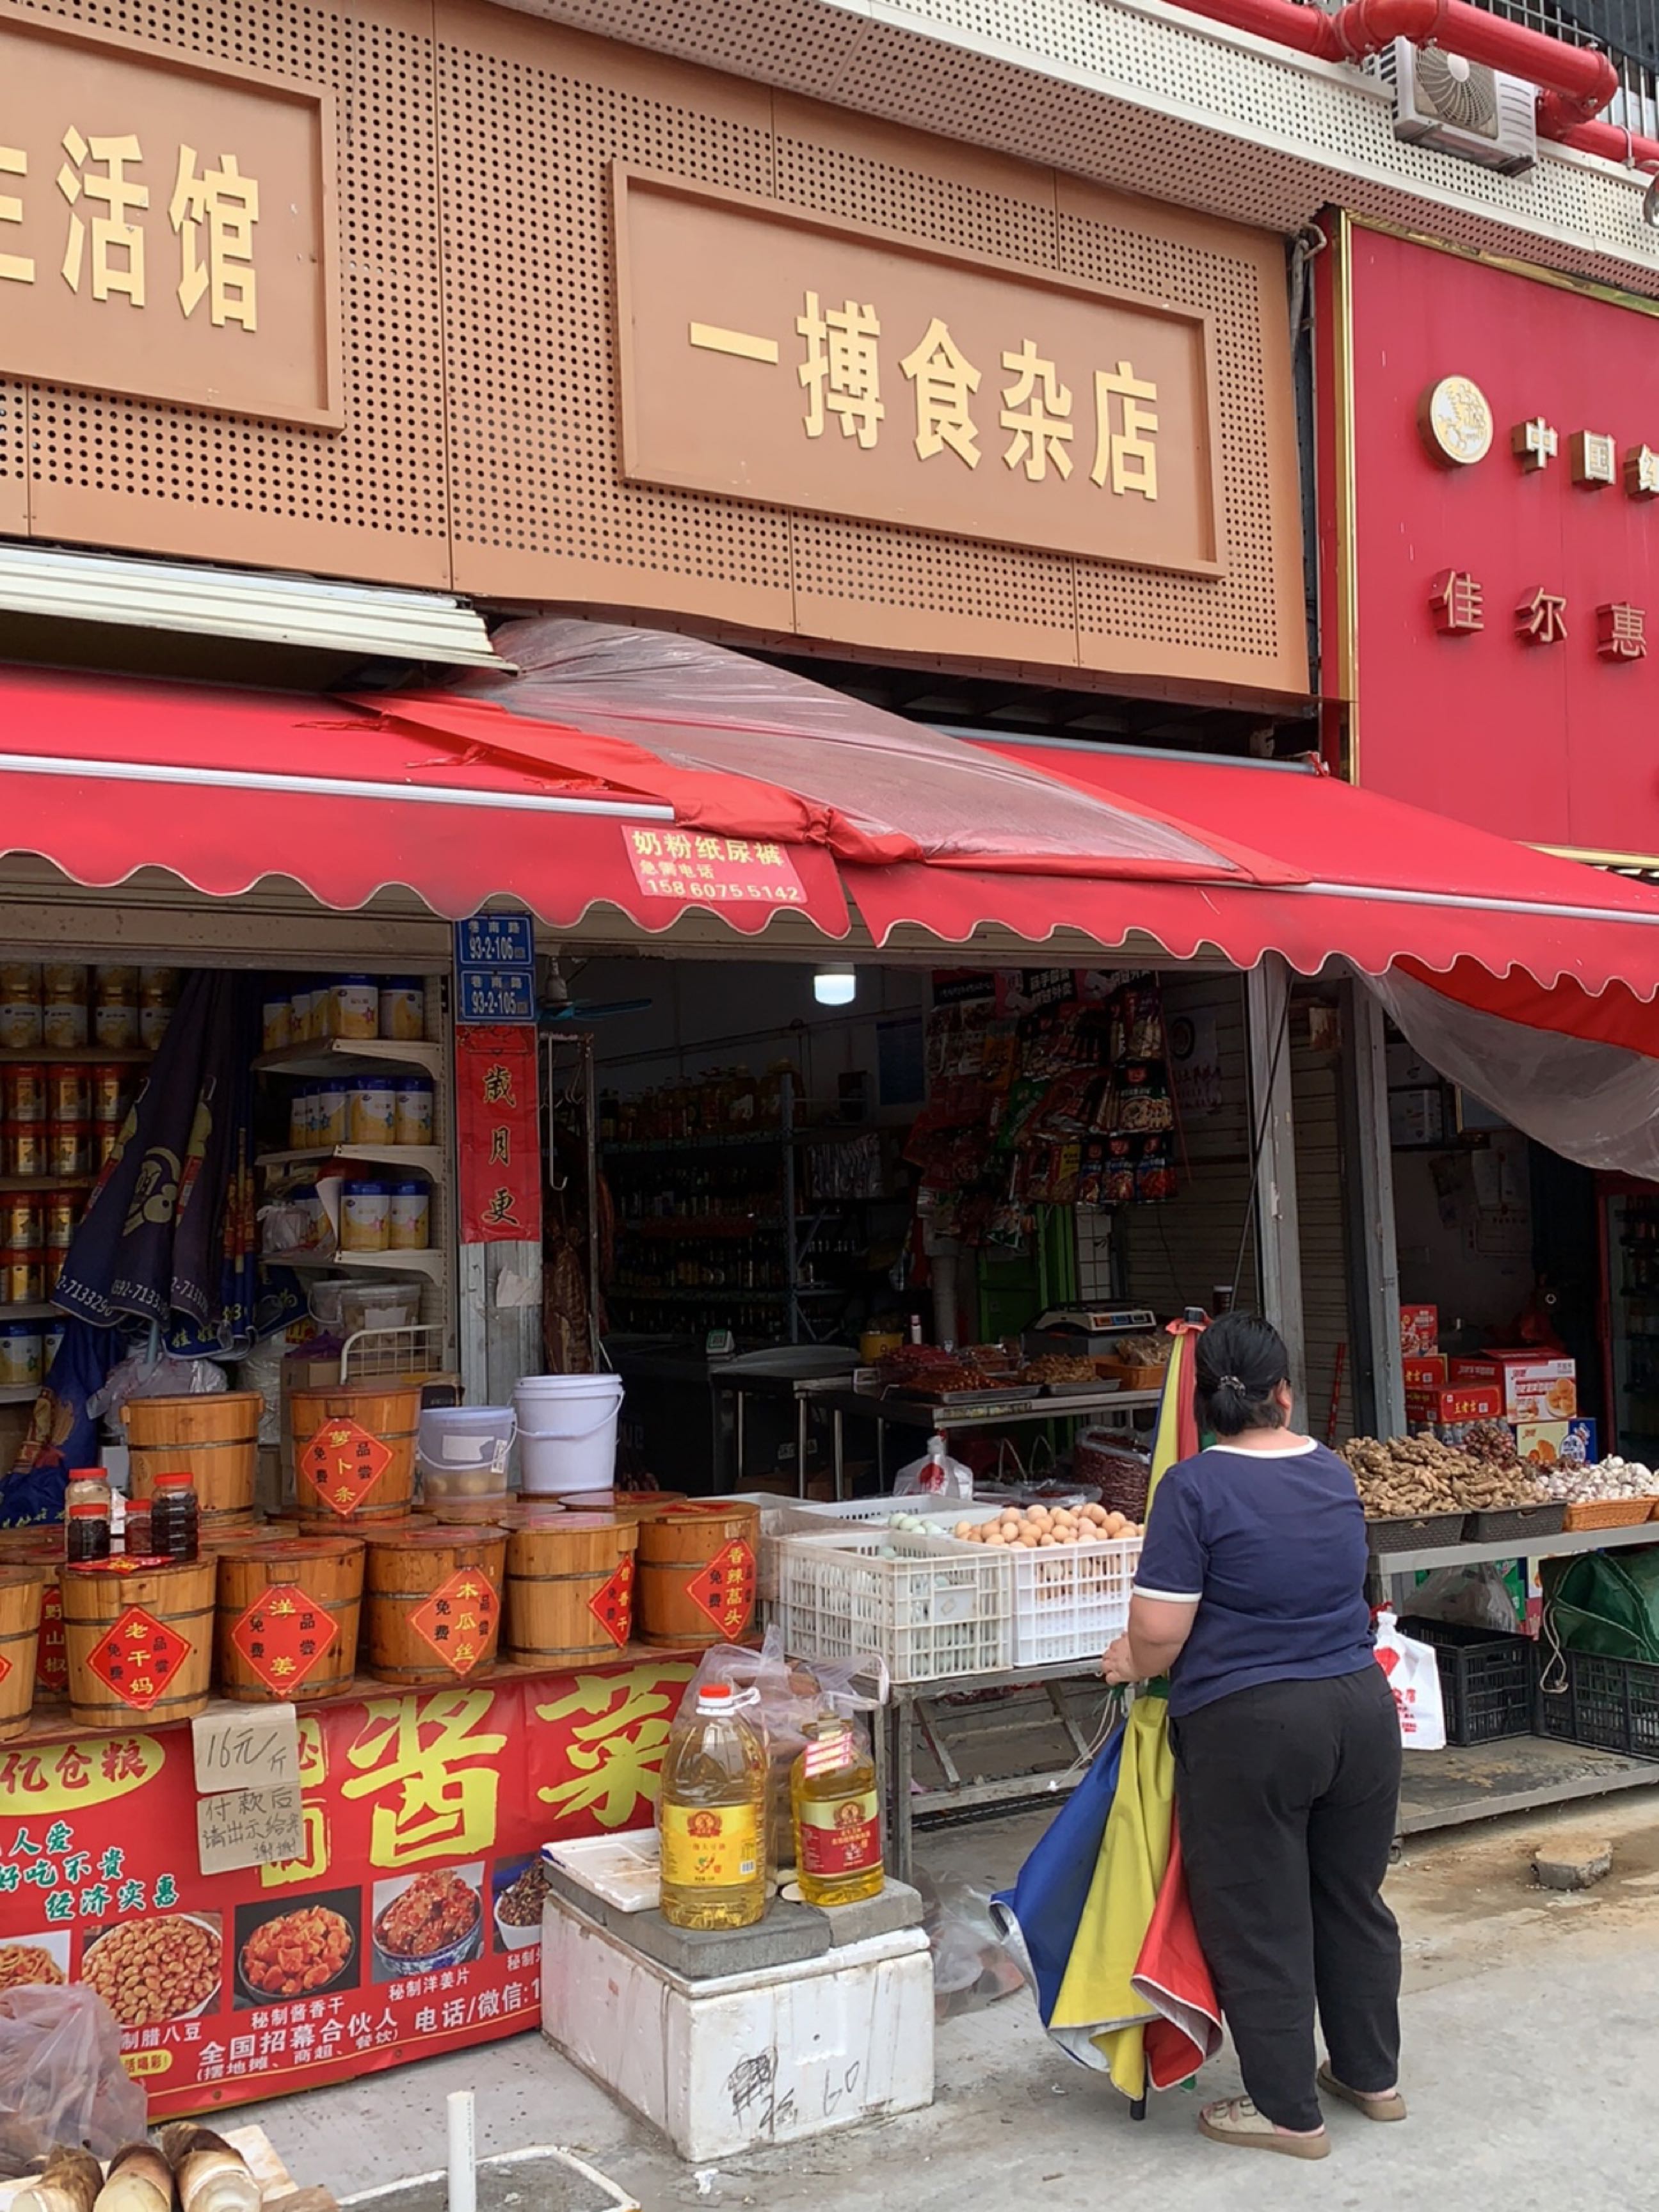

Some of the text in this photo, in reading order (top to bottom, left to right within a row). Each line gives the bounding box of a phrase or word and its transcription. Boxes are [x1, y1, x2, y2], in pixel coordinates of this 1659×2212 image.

[687, 291, 1159, 501] 一搏食杂店
[1439, 570, 1648, 659] 佳尔惠
[632, 830, 784, 866] 奶粉纸尿裤
[646, 879, 801, 901] 158 6075 5142
[1405, 1369, 1422, 1382] 老吉
[314, 1445, 328, 1484] 免费
[328, 1430, 357, 1503] 萝卜条
[356, 1441, 373, 1480] 品尝
[249, 1611, 265, 1659] 免费
[299, 1612, 316, 1656] 品尝
[434, 1599, 451, 1640] 免费
[453, 1582, 479, 1663] 木瓜丝
[107, 1642, 124, 1681] 免费
[125, 1621, 154, 1695] 老干妈
[153, 1635, 168, 1674] 品尝
[0, 1738, 148, 1795] 亿仓粮
[207, 1727, 287, 1778] 16元/斤
[205, 1786, 293, 1822] 付款后
[0, 1820, 74, 1857] 人爱
[0, 1847, 125, 1892] 好吃不贵
[45, 1873, 180, 1922] 经济实惠
[506, 1947, 541, 1972] 秘制
[388, 1967, 471, 2003] 秘制洋姜片
[251, 1995, 346, 2031] 秘制酱香干
[120, 2021, 203, 2050] 制腊八豆
[198, 2007, 398, 2067] 全国招幕合伙人
